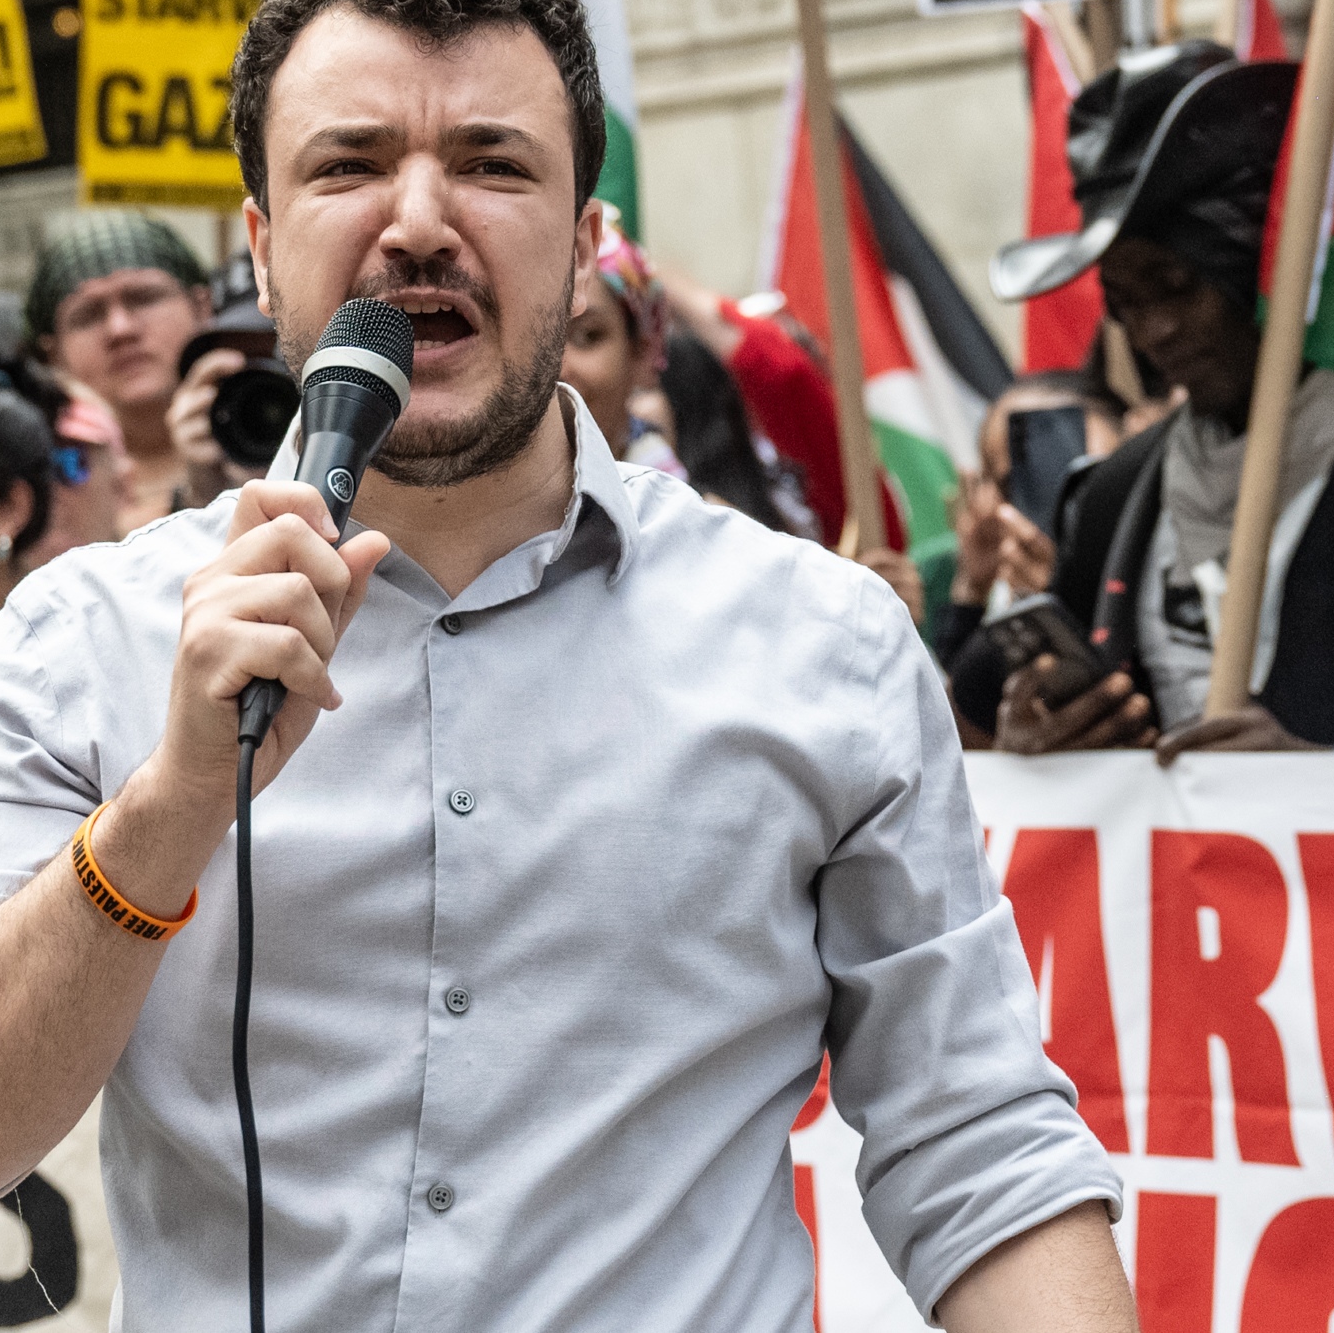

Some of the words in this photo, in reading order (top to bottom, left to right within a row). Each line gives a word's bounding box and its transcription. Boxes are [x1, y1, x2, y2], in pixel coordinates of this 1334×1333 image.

[97, 72, 233, 153] GAZ
[72, 835, 129, 923] PALESTINE
[122, 914, 168, 941] FREE
